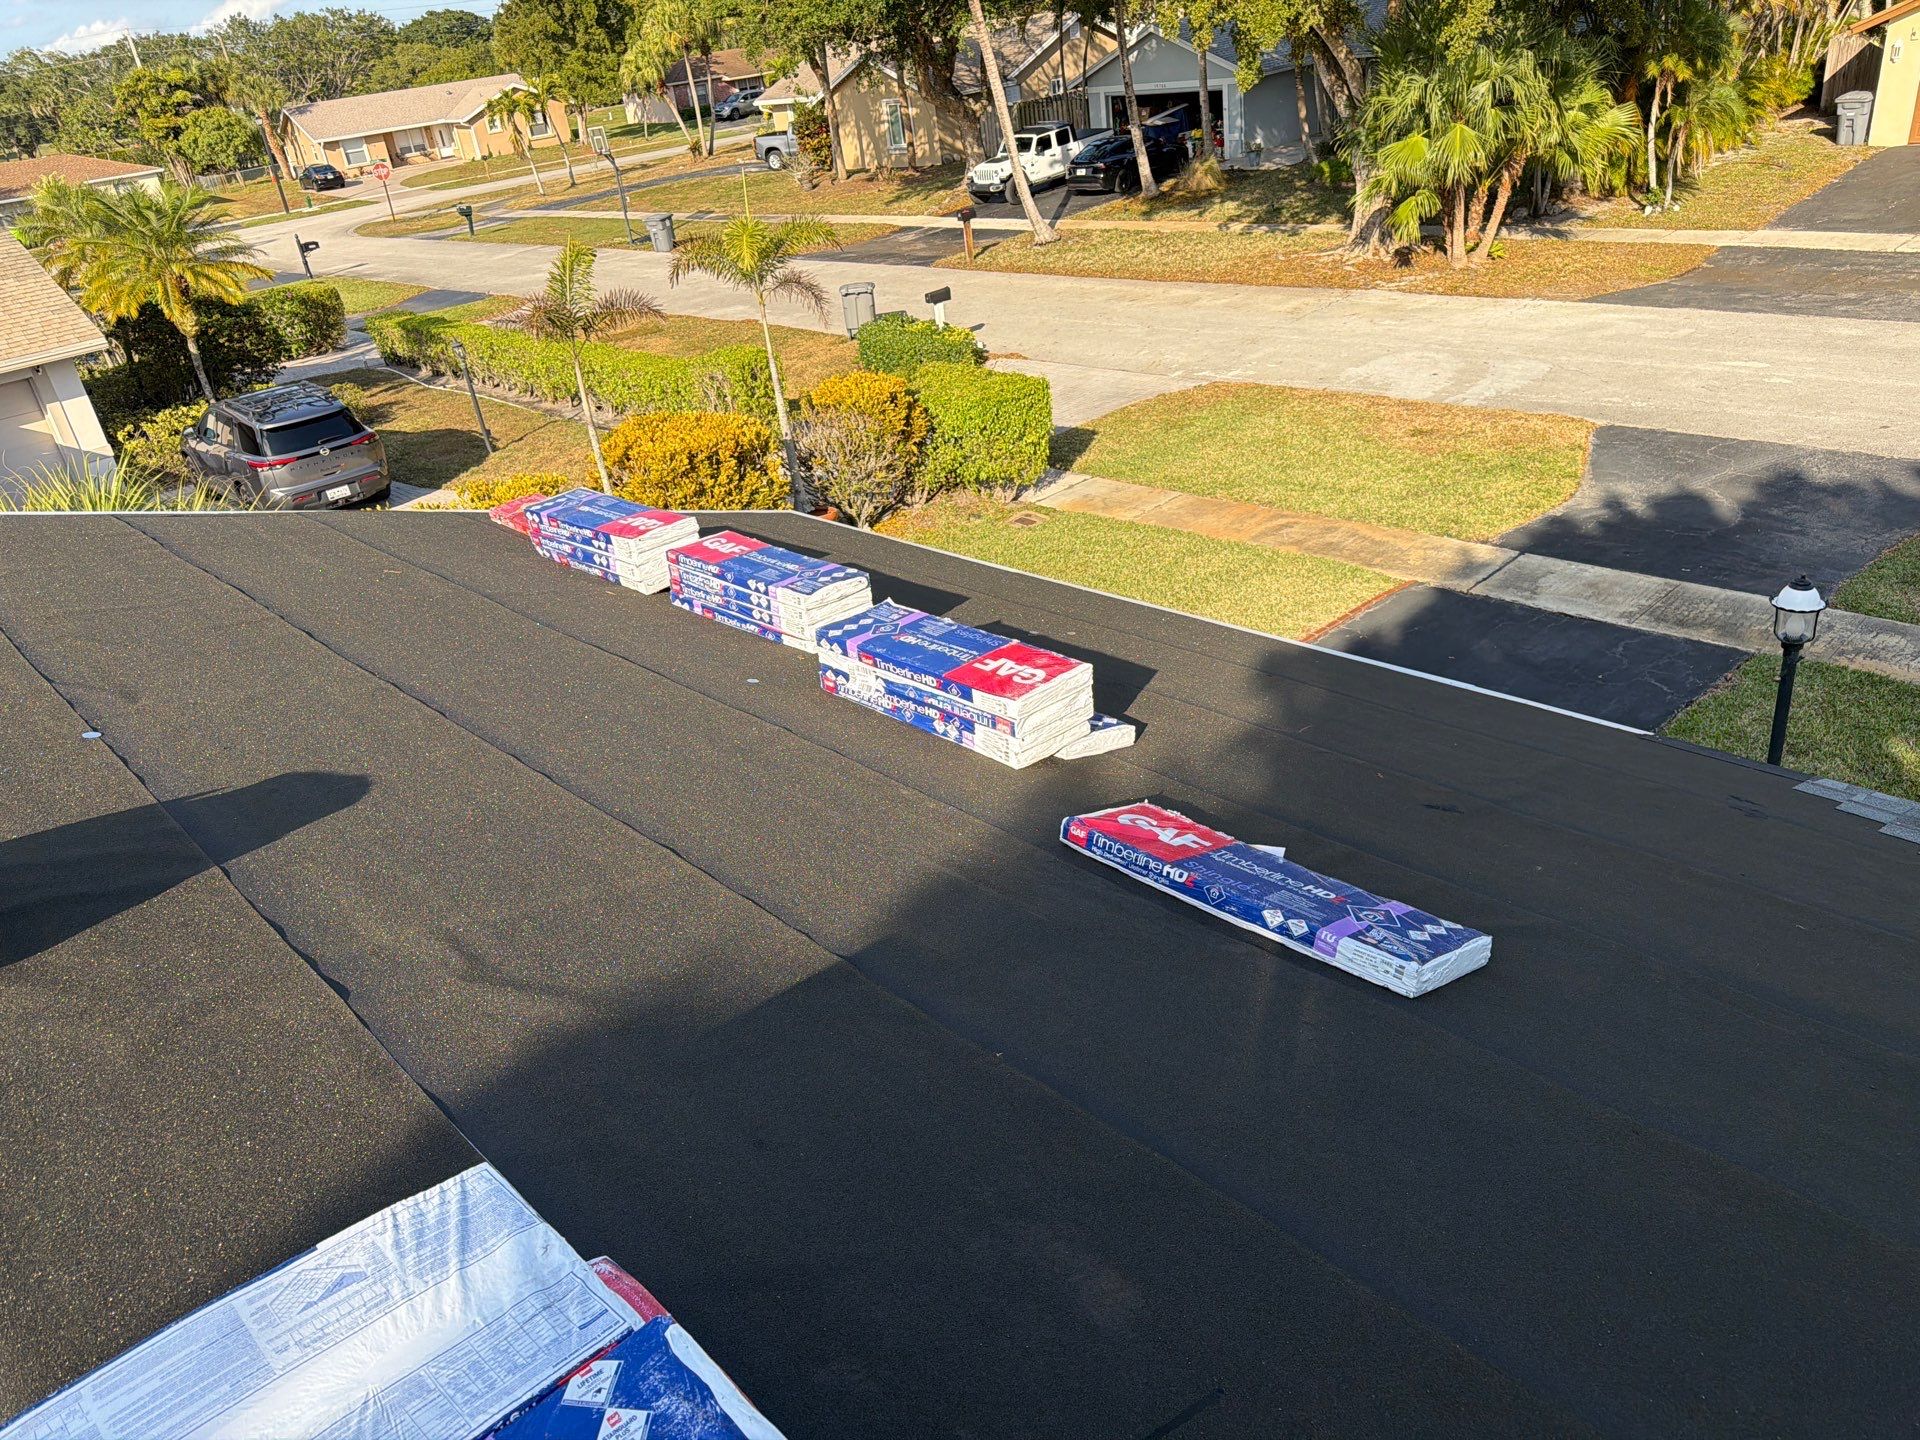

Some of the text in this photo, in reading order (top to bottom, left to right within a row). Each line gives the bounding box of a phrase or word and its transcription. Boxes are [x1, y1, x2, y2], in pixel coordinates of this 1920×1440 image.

[702, 538, 751, 553] GAF
[972, 657, 1048, 684] GAF
[1070, 825, 1086, 838] GAF
[1117, 813, 1213, 849] GAF
[576, 1367, 604, 1389] LIFETIME
